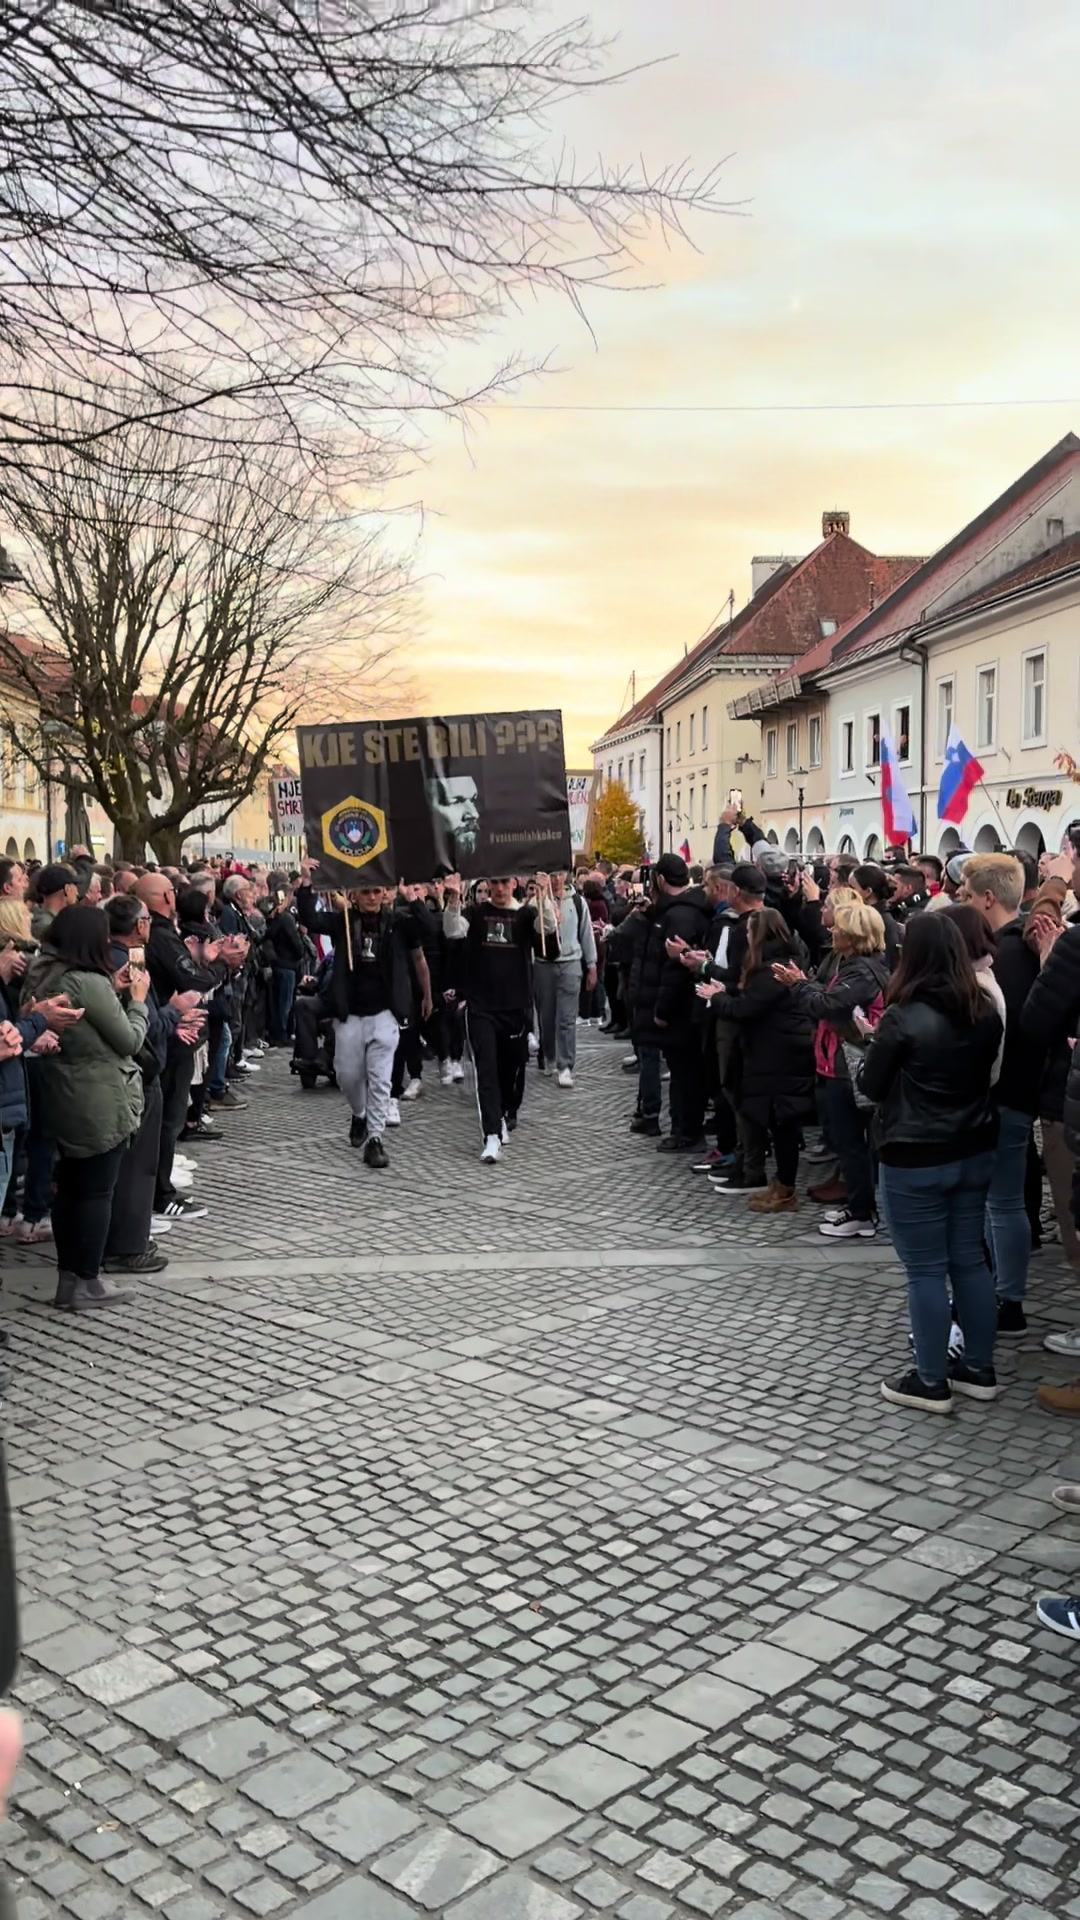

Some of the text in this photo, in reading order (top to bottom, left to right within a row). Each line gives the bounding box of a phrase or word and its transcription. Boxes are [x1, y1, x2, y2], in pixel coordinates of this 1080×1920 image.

[302, 718, 558, 768] KJE STE BILI ???
